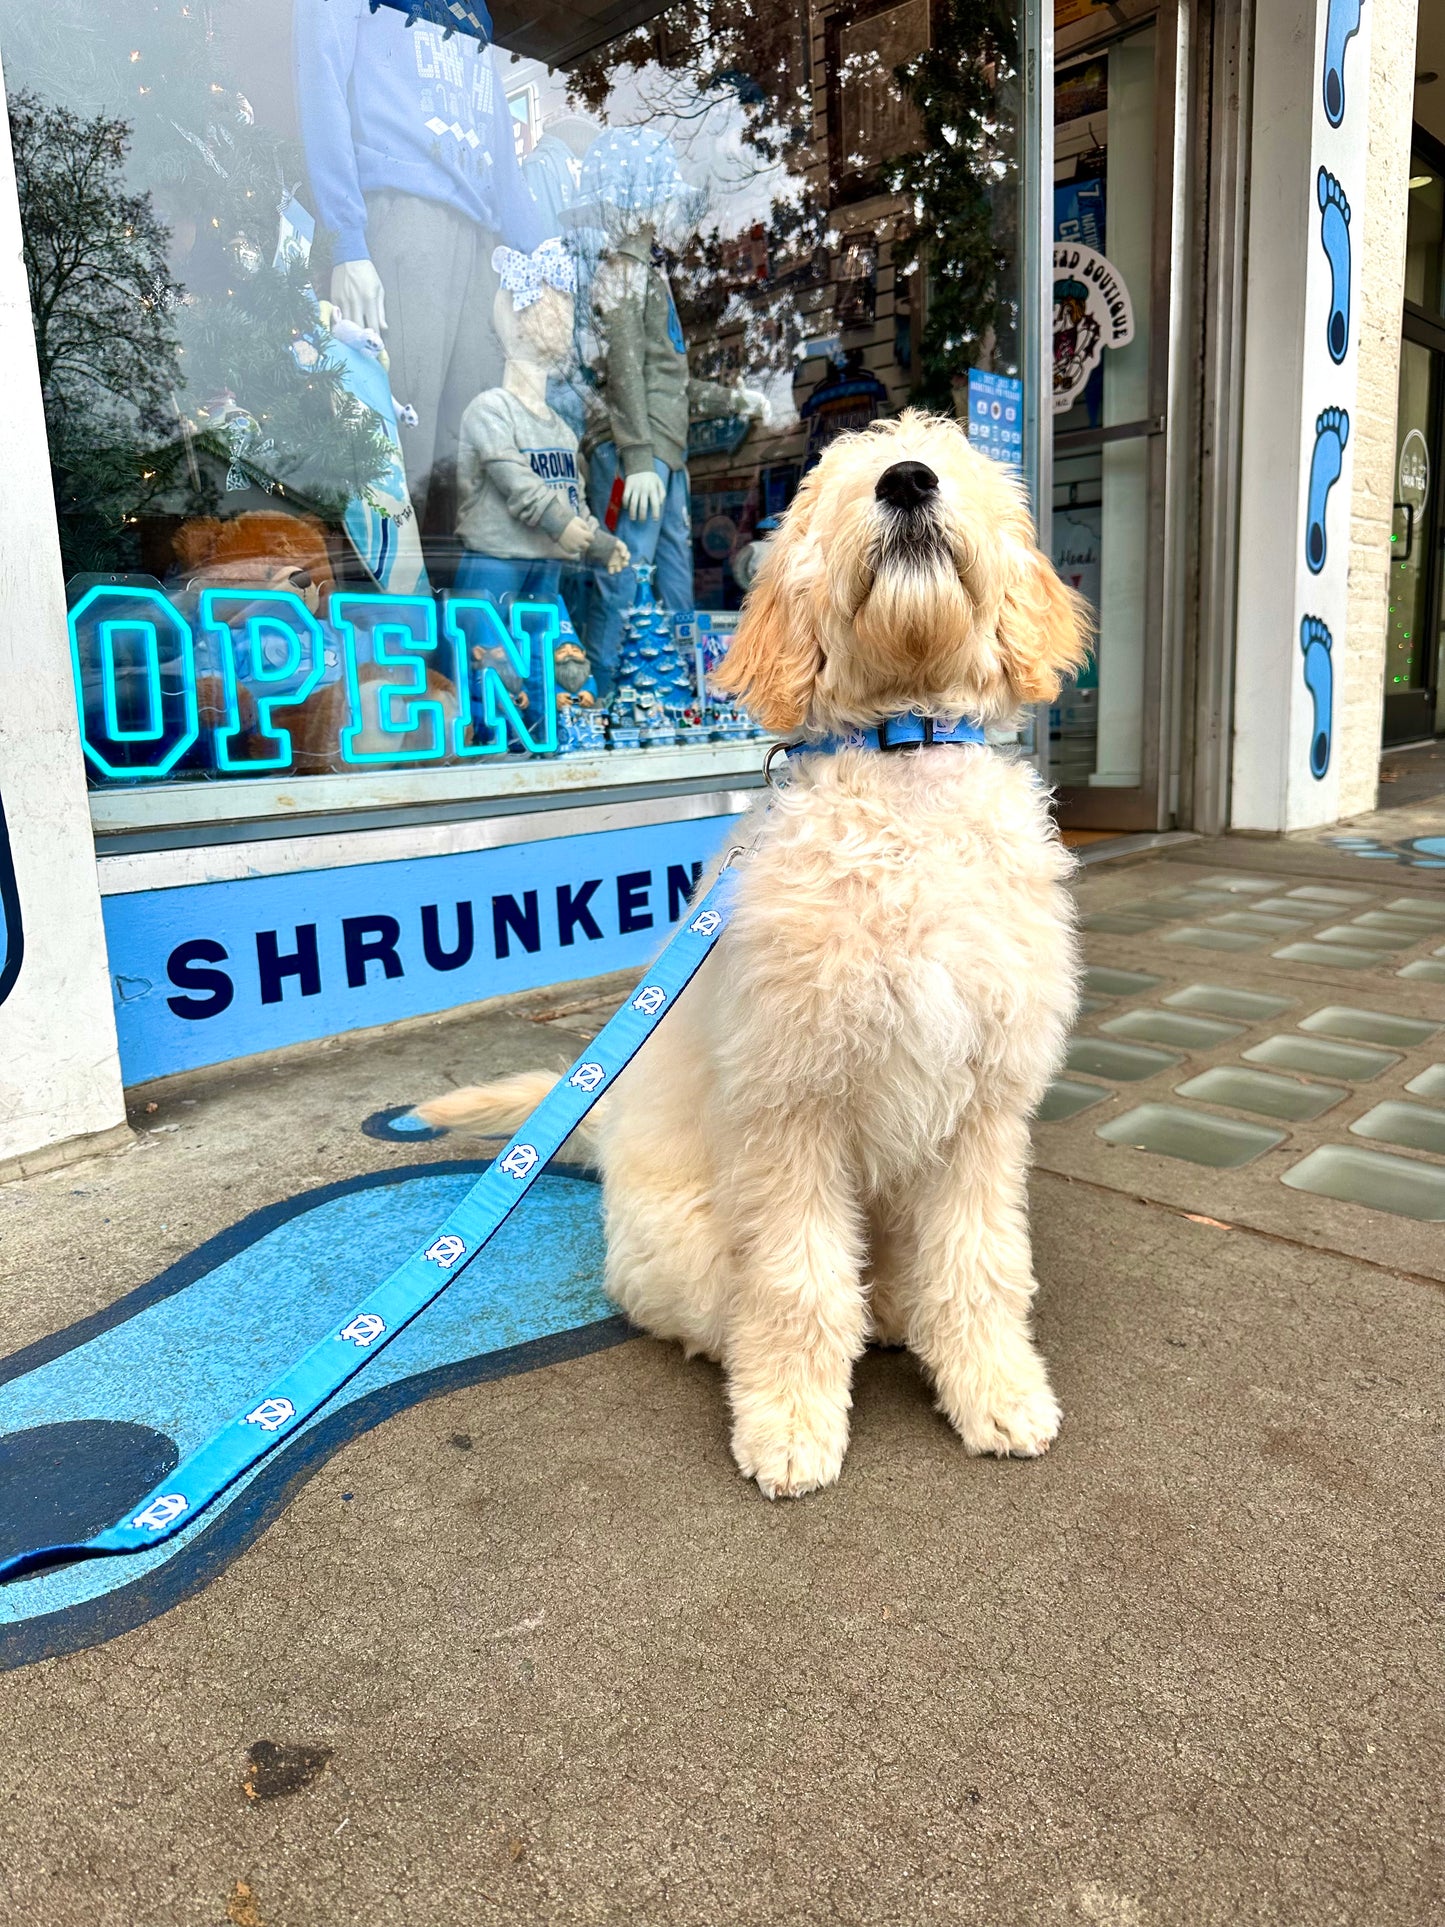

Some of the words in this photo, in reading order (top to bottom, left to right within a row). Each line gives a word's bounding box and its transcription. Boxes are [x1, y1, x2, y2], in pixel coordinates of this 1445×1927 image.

[1083, 258, 1129, 340] BOUTIQUE
[66, 585, 560, 777] OPEN
[165, 861, 703, 1020] SHRUNKEN
